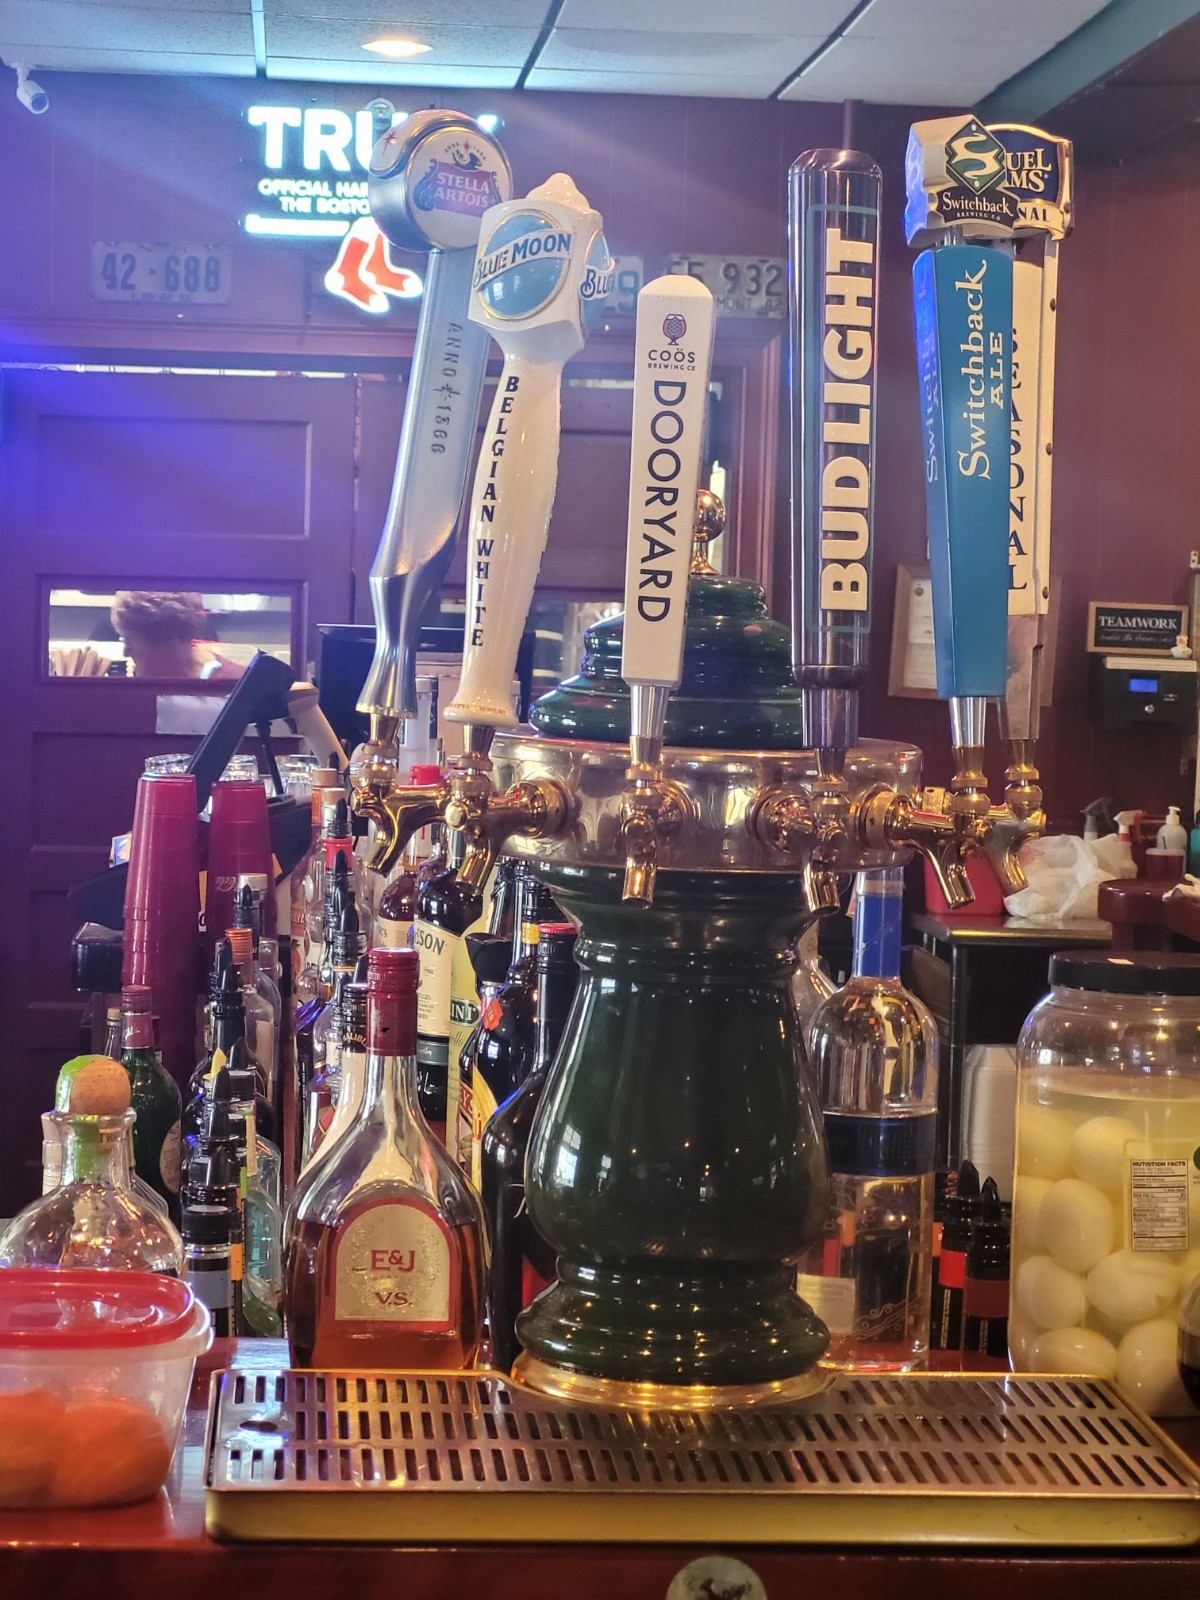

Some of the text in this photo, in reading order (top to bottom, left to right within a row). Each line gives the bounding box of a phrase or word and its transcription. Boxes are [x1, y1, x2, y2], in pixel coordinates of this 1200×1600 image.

[248, 105, 408, 171] TRU
[1006, 148, 1052, 172] UEL
[258, 179, 368, 199] OFFICIAL HAR
[437, 172, 490, 194] STELLA
[279, 196, 371, 215] THE BOSTO
[435, 187, 489, 208] ARTOIS
[942, 191, 1014, 217] Switchback
[956, 211, 989, 219] BREWING
[473, 233, 572, 288] BLUE MOON
[722, 263, 784, 297] 932
[714, 298, 752, 311] MONT
[443, 322, 464, 377] ANNO
[648, 347, 696, 363] COÖS
[647, 362, 685, 371] BREWING
[955, 259, 991, 480] Switchback
[989, 331, 1004, 410] ALE
[821, 228, 874, 611] BUD LIGHT
[471, 376, 520, 647] BELGIAN WHITE
[637, 380, 687, 623] DOORYARD
[1098, 616, 1177, 630] TEAMWORK
[370, 1250, 416, 1274] E&J
[374, 1292, 413, 1306] V.S.
